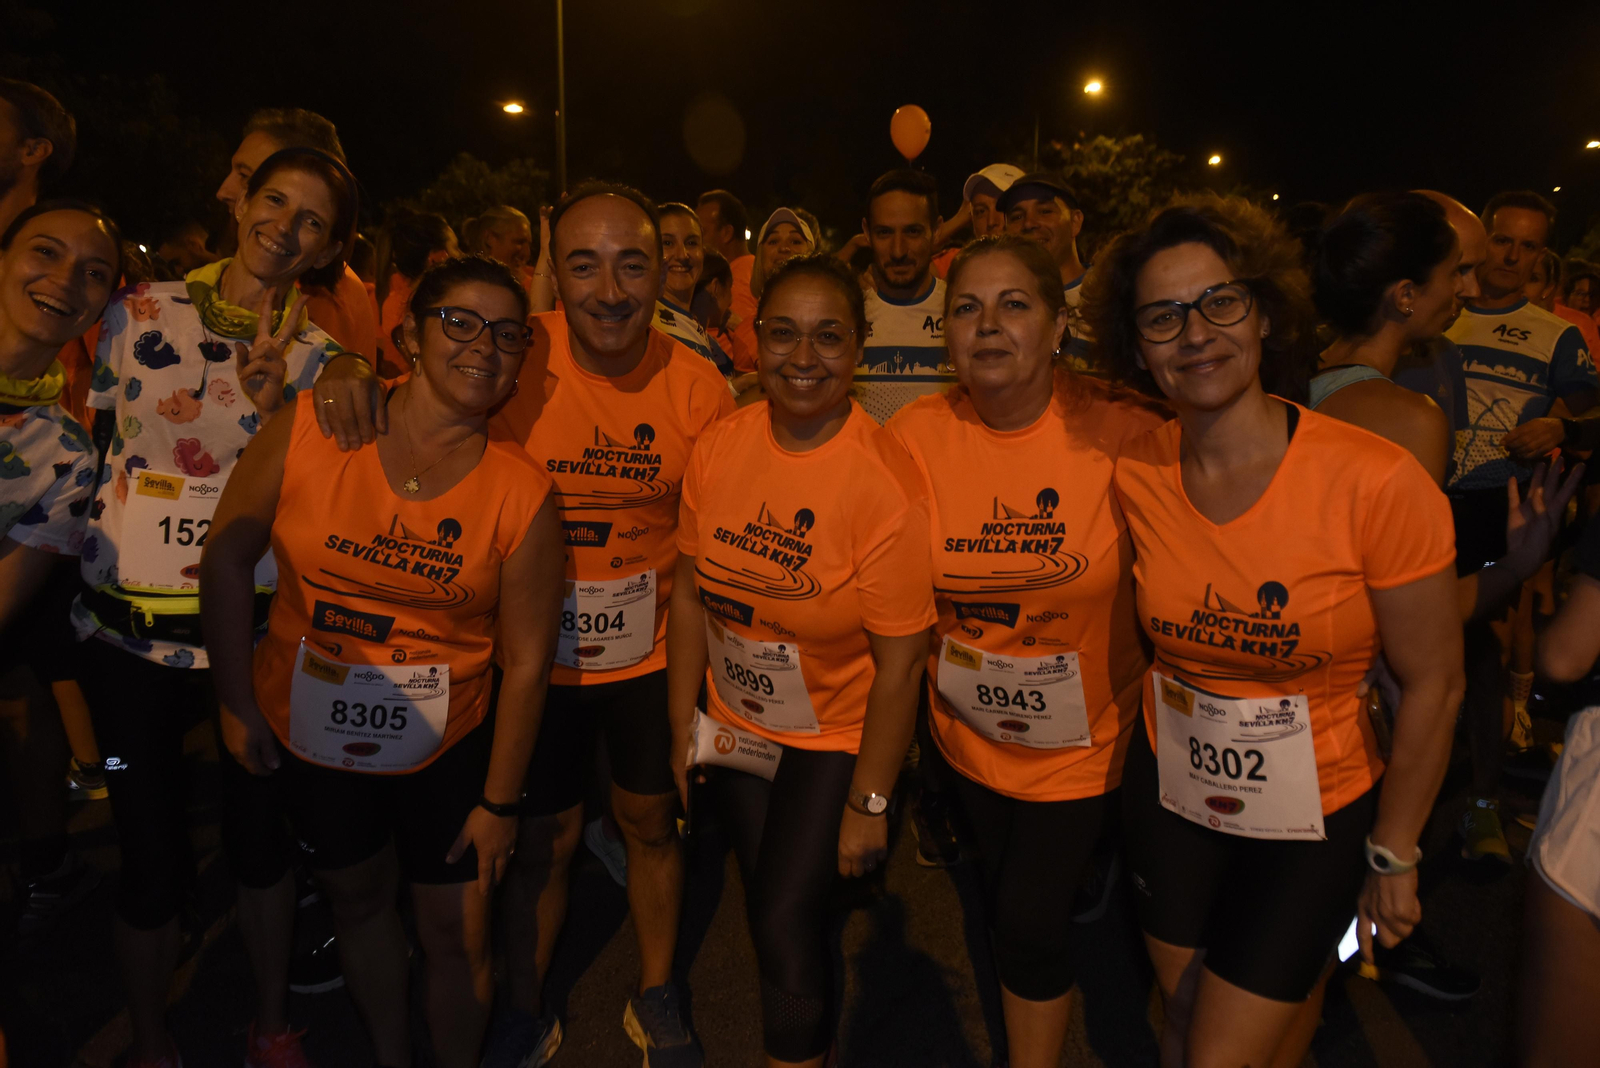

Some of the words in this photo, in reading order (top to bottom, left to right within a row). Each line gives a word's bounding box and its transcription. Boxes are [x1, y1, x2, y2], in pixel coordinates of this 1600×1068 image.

[923, 315, 944, 333] AC
[1492, 324, 1532, 341] ACS
[1576, 348, 1596, 369] AC
[583, 448, 662, 465] NOCTURNA
[546, 459, 617, 478] SEVILLA
[981, 522, 1066, 535] NOCTURNA
[713, 527, 770, 558] SEVILLA
[743, 522, 813, 557] NOCTURNA
[944, 537, 1017, 553] SEVILLA
[324, 534, 411, 572] SEVILLA
[371, 534, 463, 567] NOCTURNA
[561, 610, 625, 634] 8304
[1191, 610, 1301, 638] NOCTURNA
[1150, 617, 1237, 650] SEVILLA
[724, 657, 774, 696] 8899
[1037, 663, 1068, 671] NOCTURNA
[976, 684, 1046, 712] 8943
[331, 700, 408, 731] 8305
[1255, 711, 1295, 720] NOCTURNA
[324, 726, 346, 735] MIRIAM
[738, 736, 768, 750] nationale
[738, 746, 776, 762] nederlanden
[1189, 736, 1267, 782] 8302
[1200, 777, 1238, 792] CABALLERO
